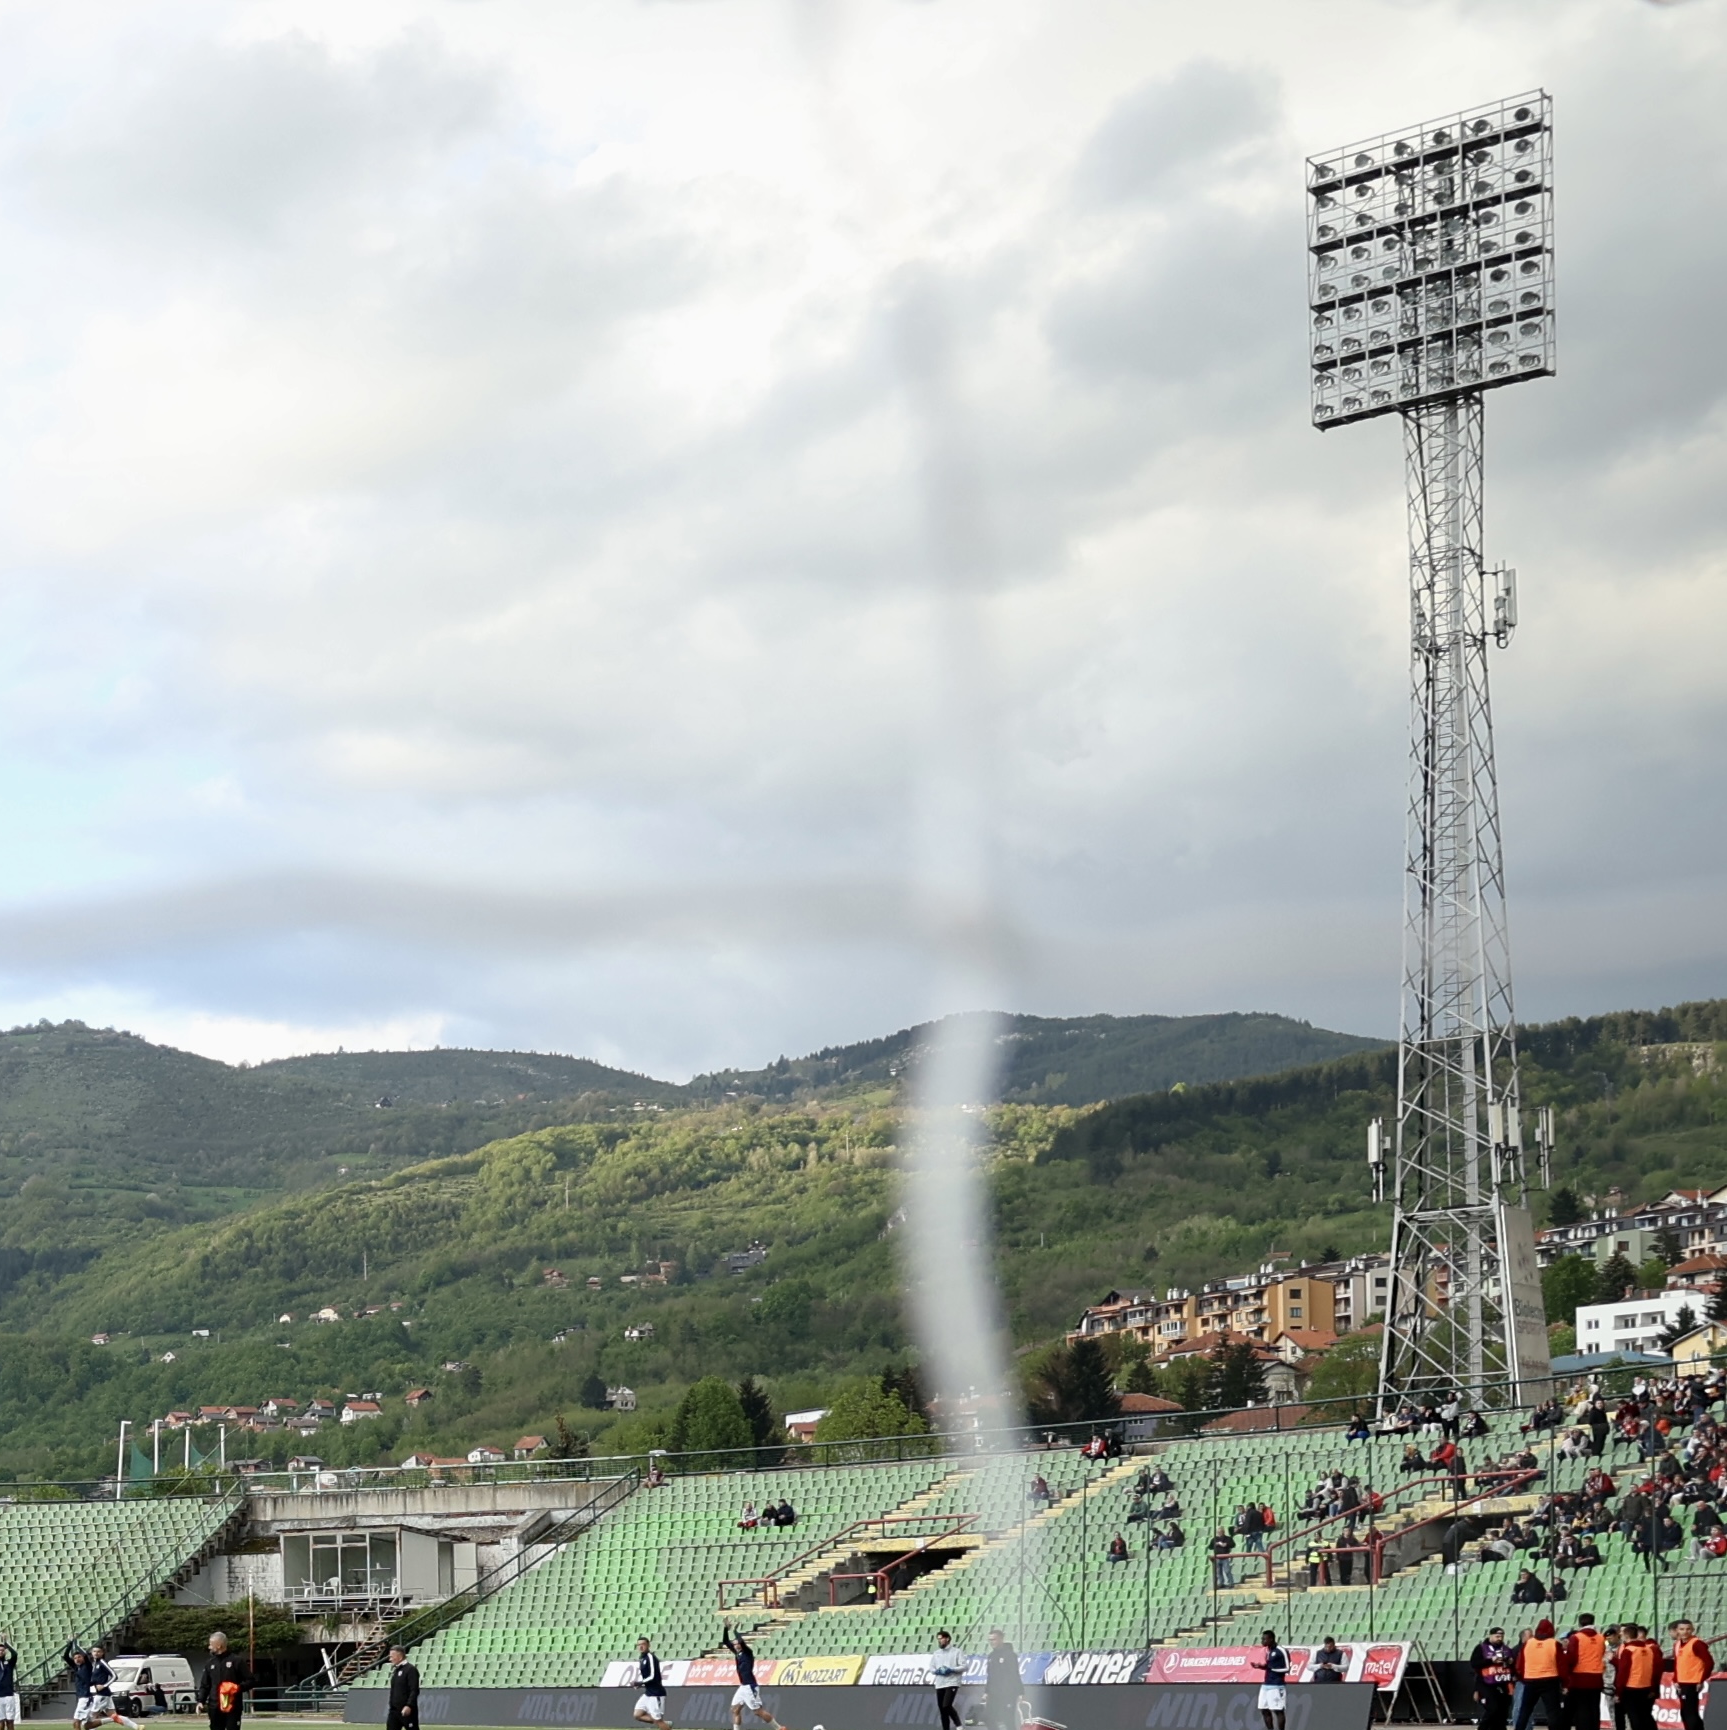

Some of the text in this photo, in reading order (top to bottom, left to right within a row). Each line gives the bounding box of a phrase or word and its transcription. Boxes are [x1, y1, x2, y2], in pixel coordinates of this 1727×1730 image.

[1180, 1656, 1247, 1667] TURKISH AIRLINES
[800, 1668, 848, 1683] MOZZART
[873, 1663, 936, 1685] telemac
